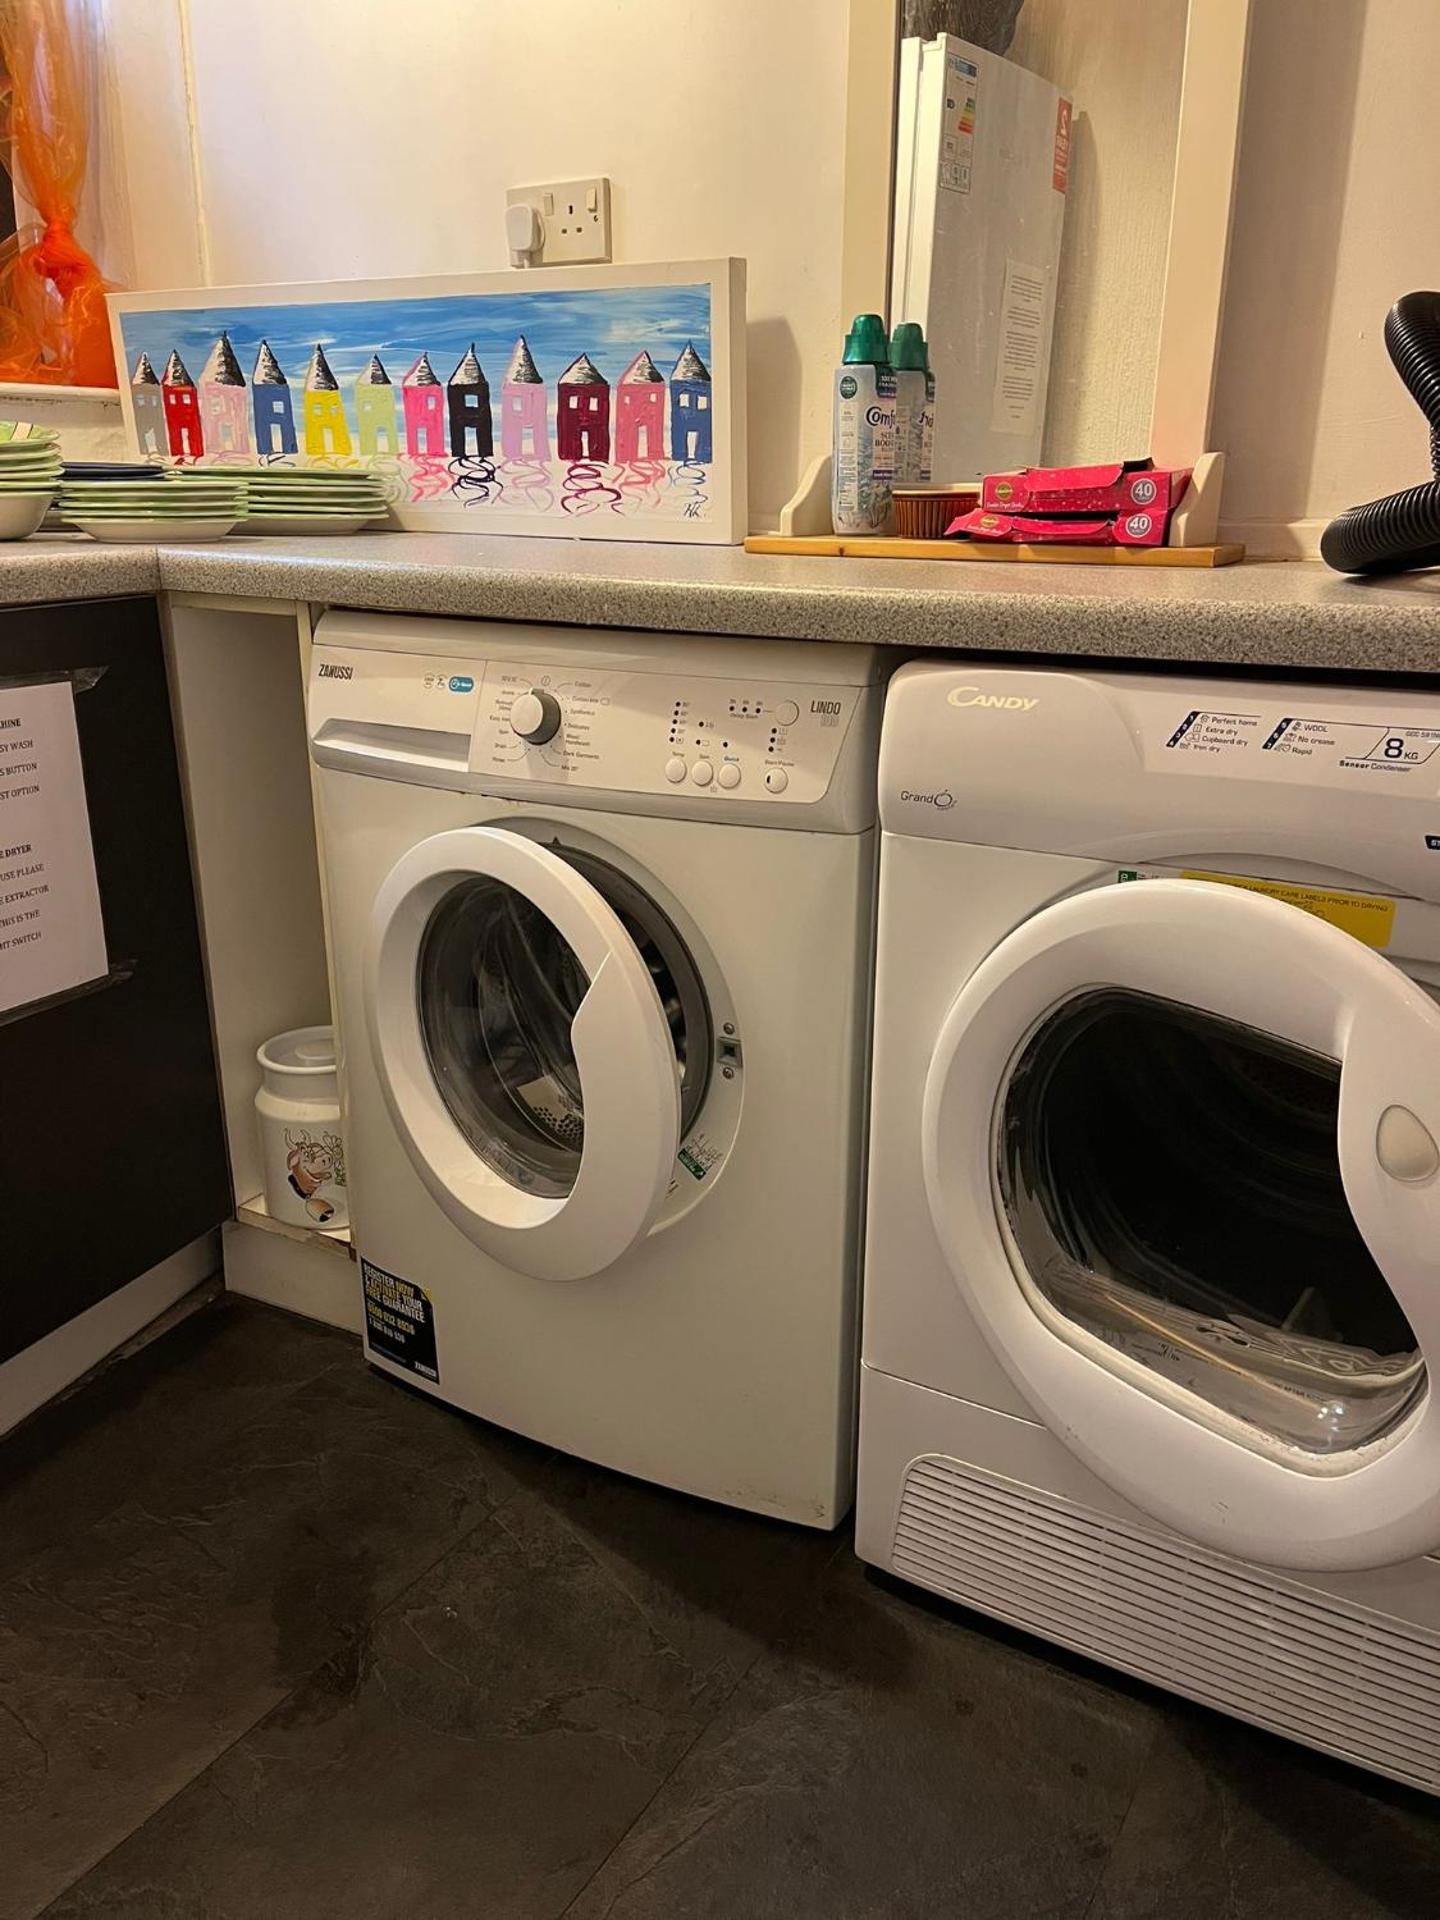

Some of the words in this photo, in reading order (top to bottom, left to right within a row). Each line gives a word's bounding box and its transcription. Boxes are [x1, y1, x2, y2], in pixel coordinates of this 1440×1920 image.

[1134, 483, 1154, 498] 40
[1129, 516, 1150, 531] 40
[318, 663, 354, 680] ZANUSSI
[811, 699, 841, 715] LINDO
[1211, 716, 1238, 725] Perfect
[1303, 725, 1329, 733] WOOL
[10, 739, 33, 750] WASH
[1384, 737, 1404, 759] 8
[1403, 751, 1419, 761] KG
[6, 763, 38, 776] BUTTON
[1339, 760, 1370, 770] Sensor
[11, 785, 40, 797] OPTION
[5, 844, 32, 857] DRYER
[17, 863, 45, 878] PLEASE
[5, 884, 50, 903] EXTRACTOR
[1300, 893, 1328, 903] LABELS
[24, 909, 40, 921] THE
[12, 931, 41, 946] SWITCH
